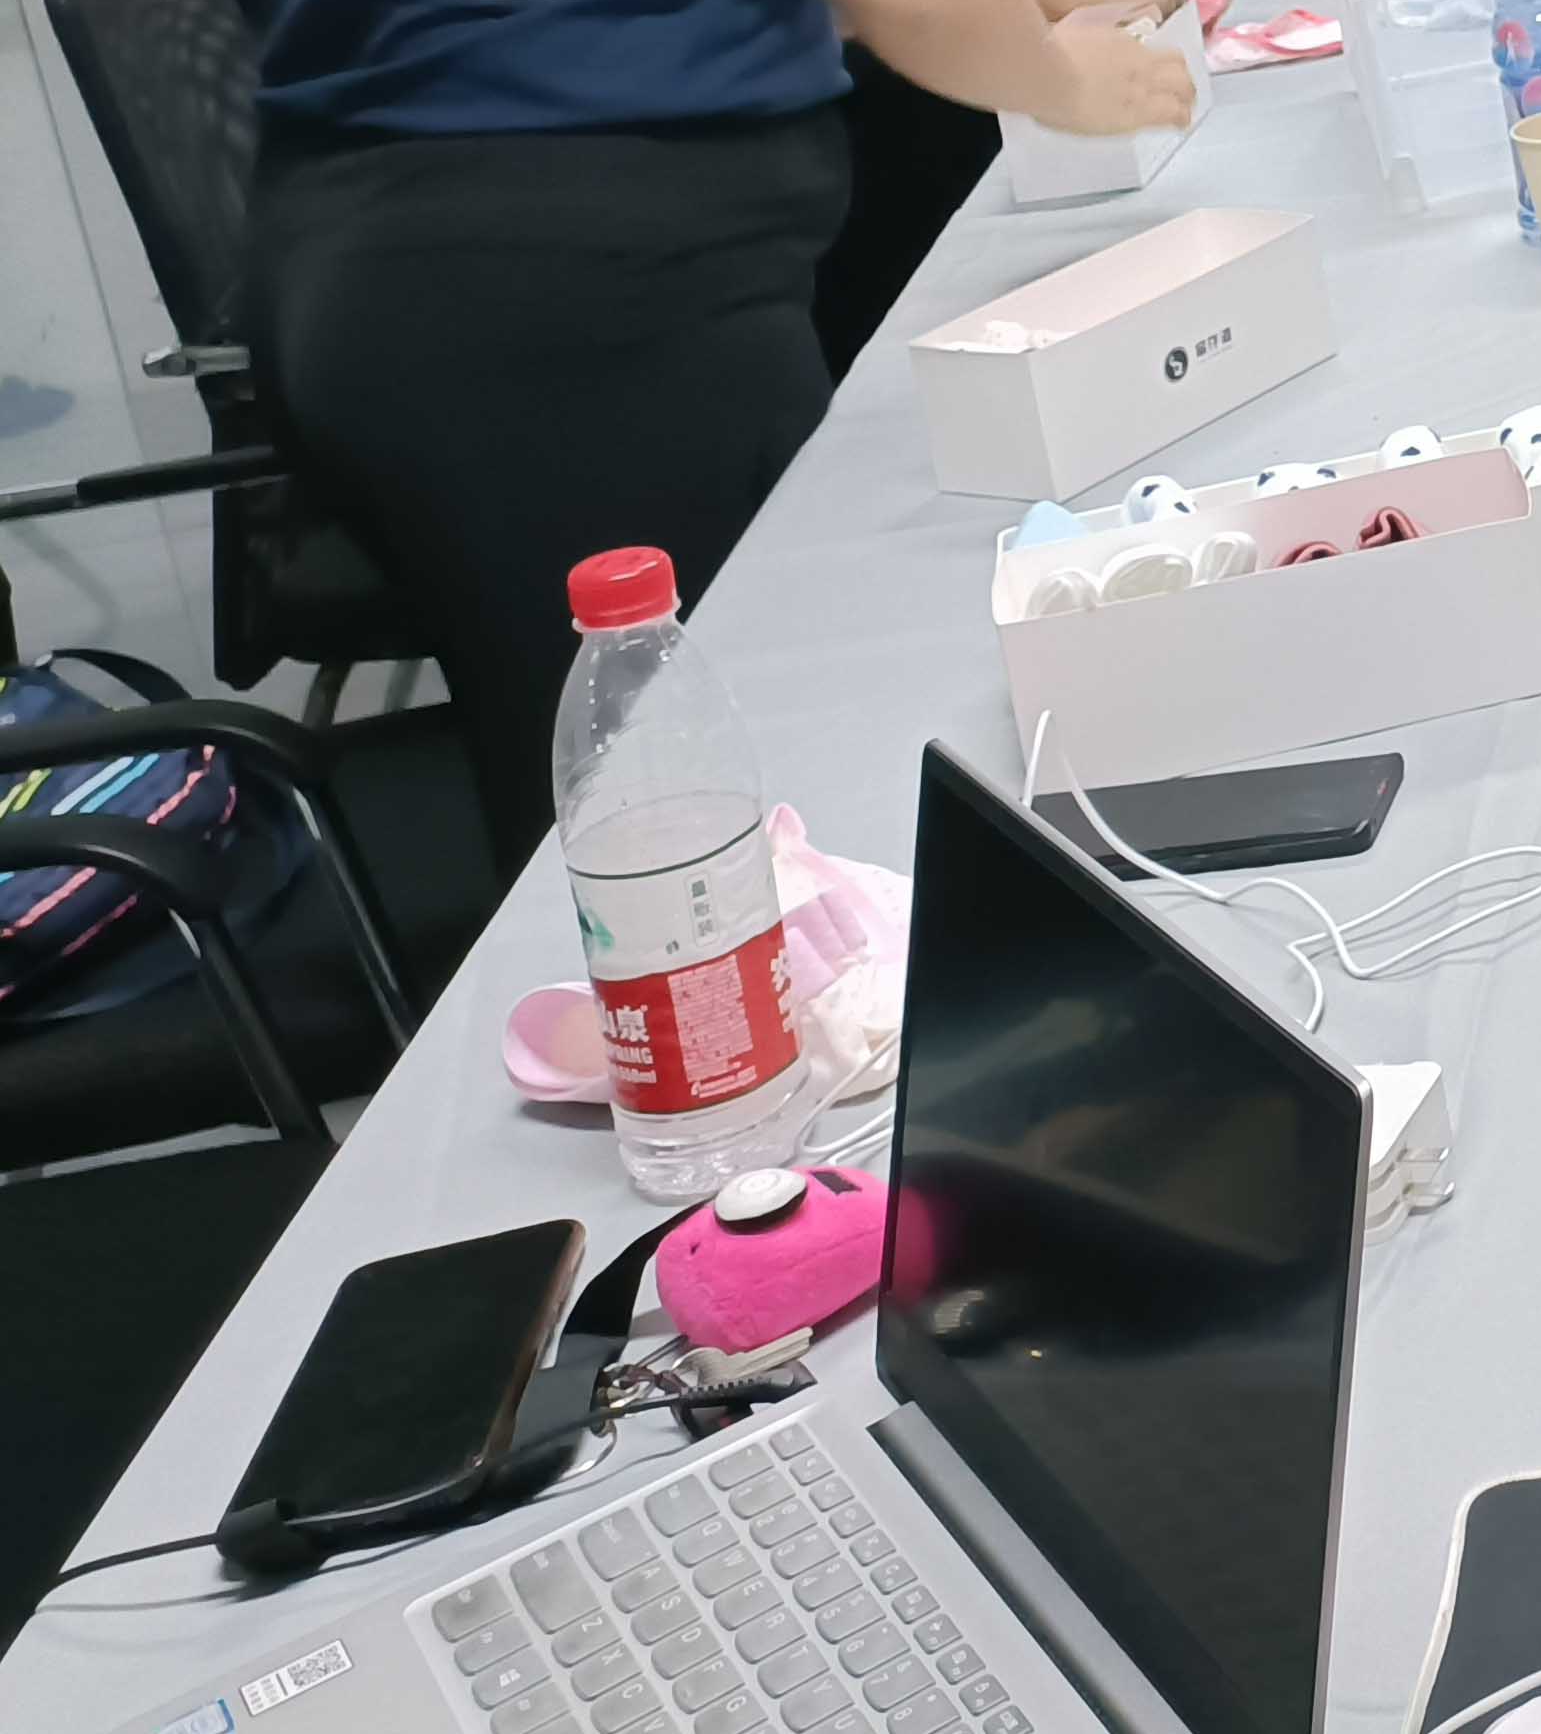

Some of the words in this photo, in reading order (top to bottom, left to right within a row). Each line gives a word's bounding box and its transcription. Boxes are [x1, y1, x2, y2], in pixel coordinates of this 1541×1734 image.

[744, 1580, 763, 1596] E
[661, 1596, 680, 1610] S
[581, 1616, 603, 1632] Z
[681, 1627, 701, 1643] D
[602, 1648, 624, 1665] X
[703, 1660, 725, 1672] F
[622, 1683, 643, 1699] C
[726, 1696, 746, 1713] G
